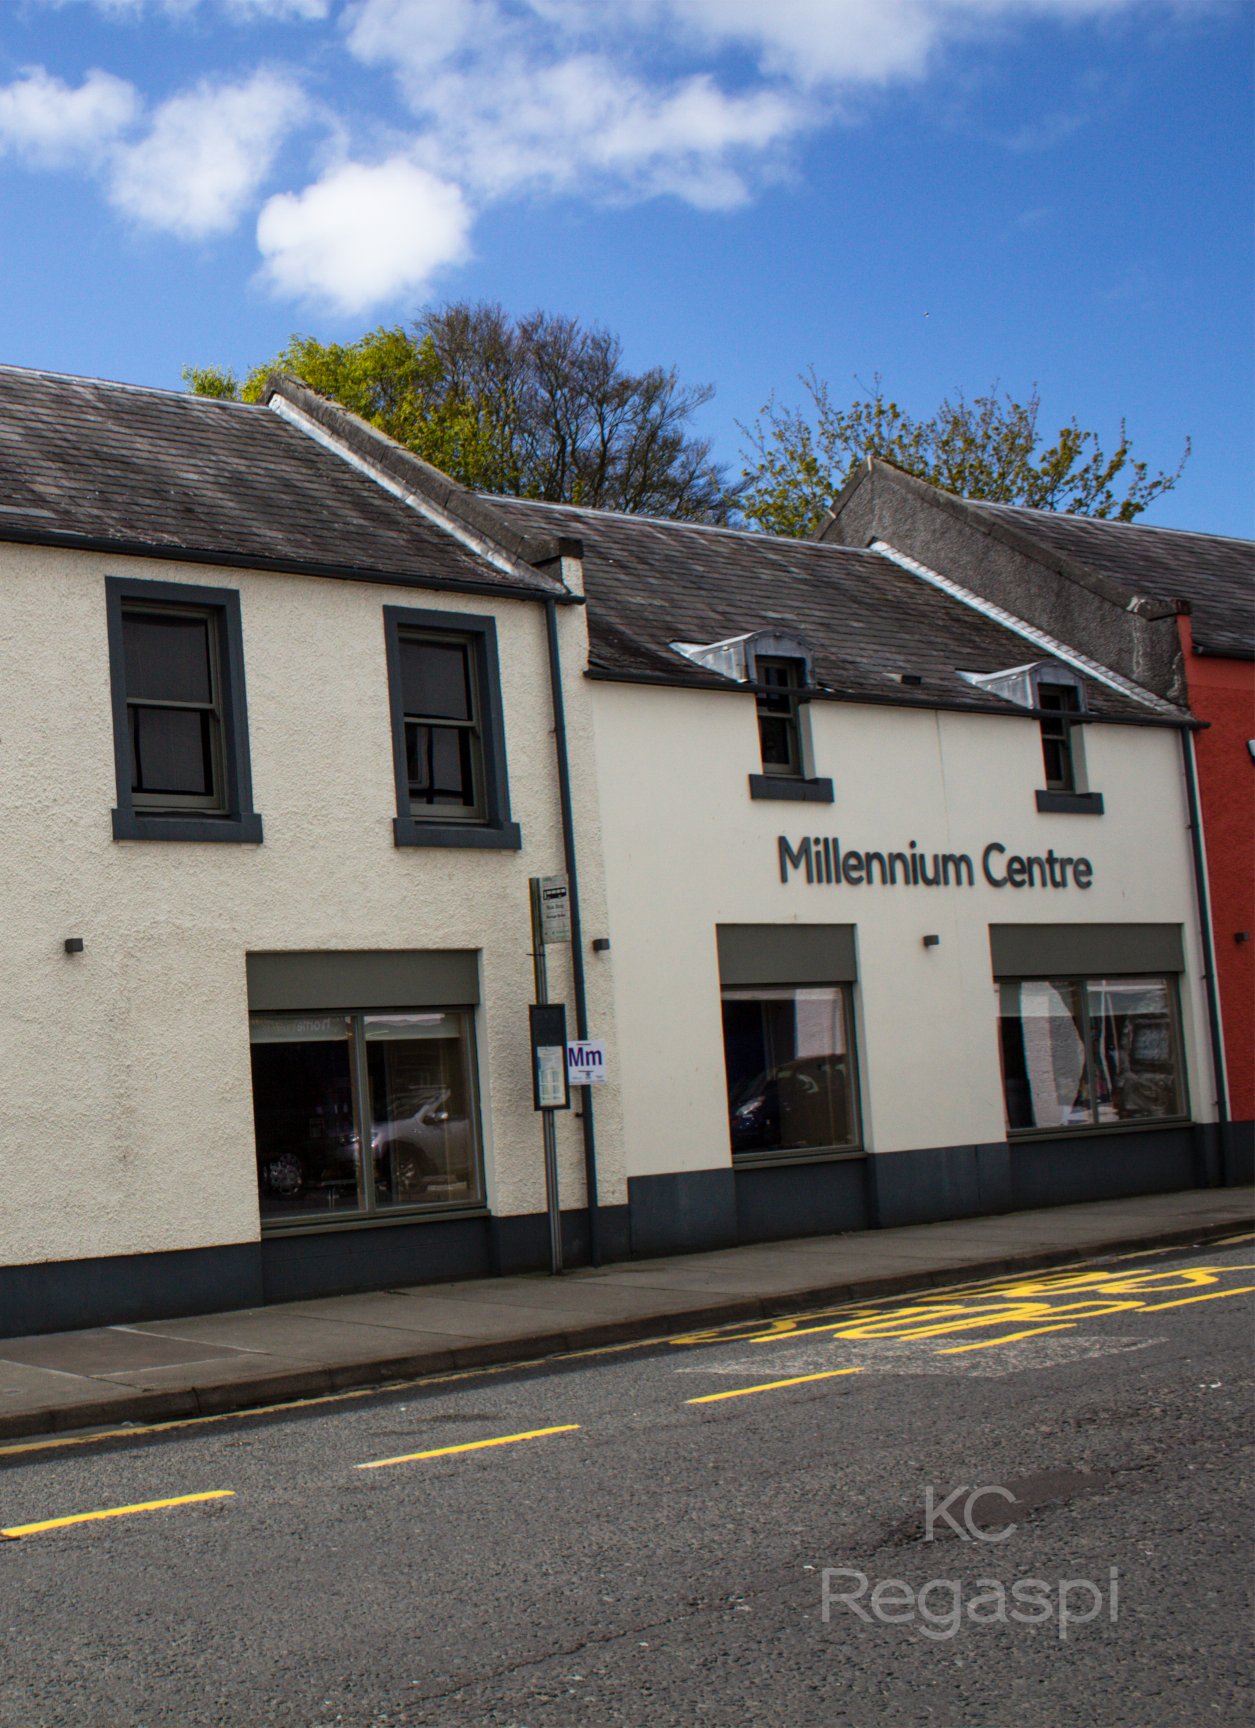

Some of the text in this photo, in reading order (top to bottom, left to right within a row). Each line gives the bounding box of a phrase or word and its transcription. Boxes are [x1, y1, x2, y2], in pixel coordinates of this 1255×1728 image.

[778, 836, 1093, 889] Millennium Centre
[568, 1047, 603, 1067] Mm
[669, 1300, 1147, 1344] STOP
